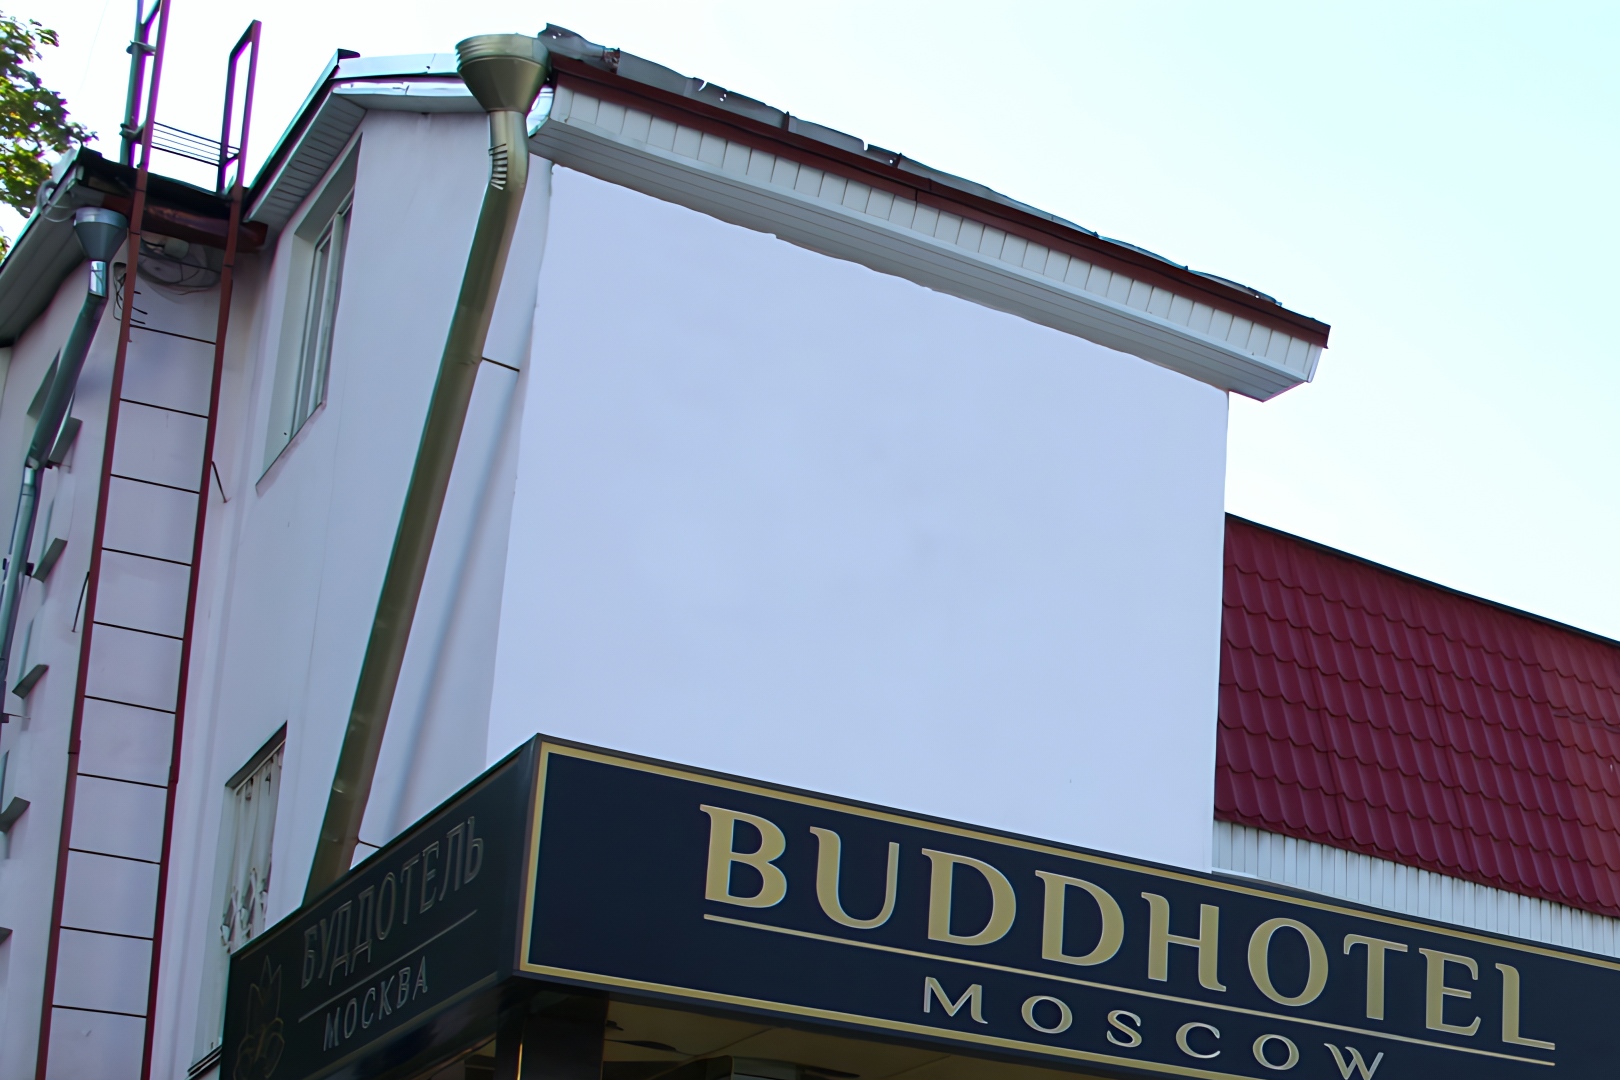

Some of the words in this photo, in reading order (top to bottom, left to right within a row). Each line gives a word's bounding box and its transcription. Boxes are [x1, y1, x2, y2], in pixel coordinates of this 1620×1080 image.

[301, 815, 484, 989] БУДДОТЕЛЬ
[699, 803, 1556, 1051] BUDDHOTEL
[322, 955, 428, 1052] МОСКВА
